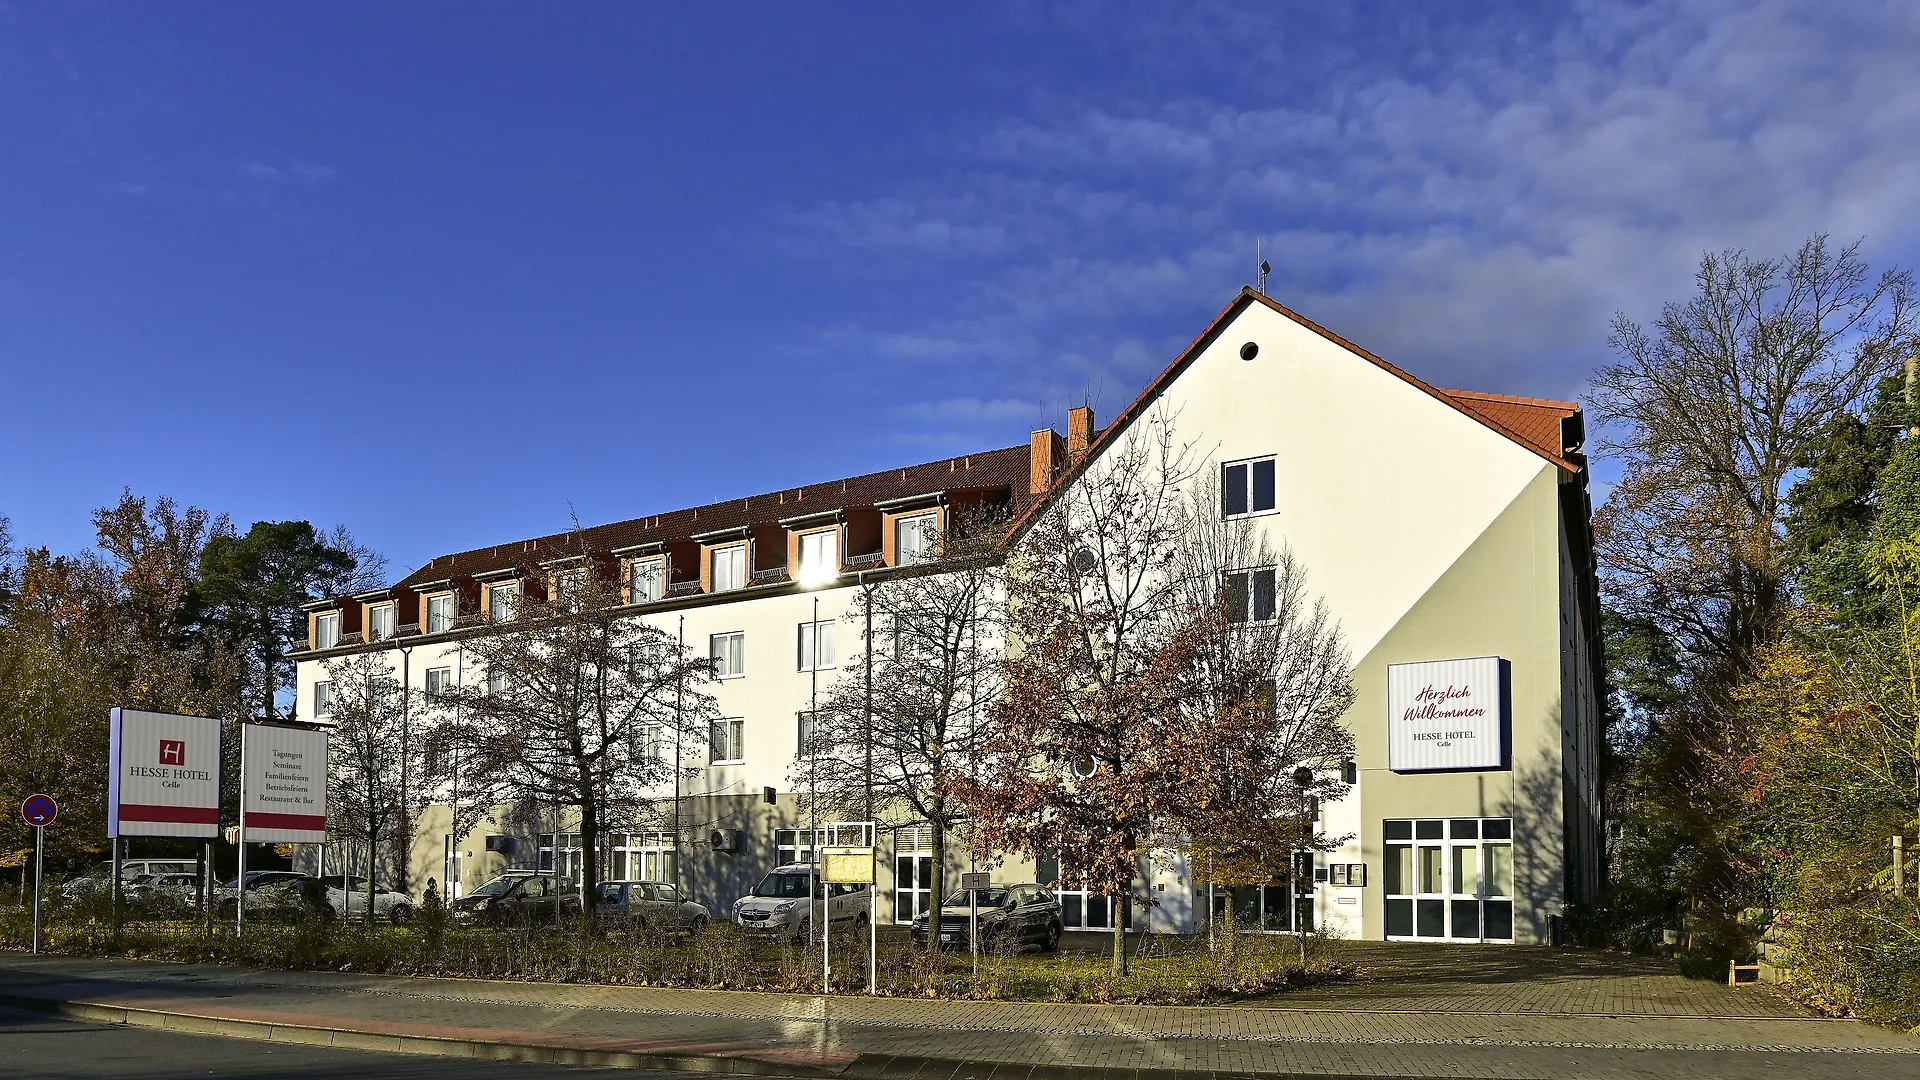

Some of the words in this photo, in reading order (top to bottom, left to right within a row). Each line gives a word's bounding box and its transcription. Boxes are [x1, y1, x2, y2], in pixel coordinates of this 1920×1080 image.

[1415, 684, 1471, 705] Herzlich
[1403, 703, 1486, 721] Willkommen
[1413, 732, 1443, 741] HESSE
[1445, 731, 1476, 740] HOTEL
[272, 749, 303, 760] Tagungen
[272, 761, 302, 770] Seminare
[130, 766, 169, 778] HESSE
[173, 769, 212, 781] HOTEL
[265, 771, 309, 782] Familienfeiern
[162, 780, 181, 789] Celle
[265, 783, 308, 793] Betriebsfeiern
[259, 794, 293, 804] Restaurant
[294, 796, 301, 804] &
[302, 797, 314, 805] Bar
[972, 875, 980, 887] H
